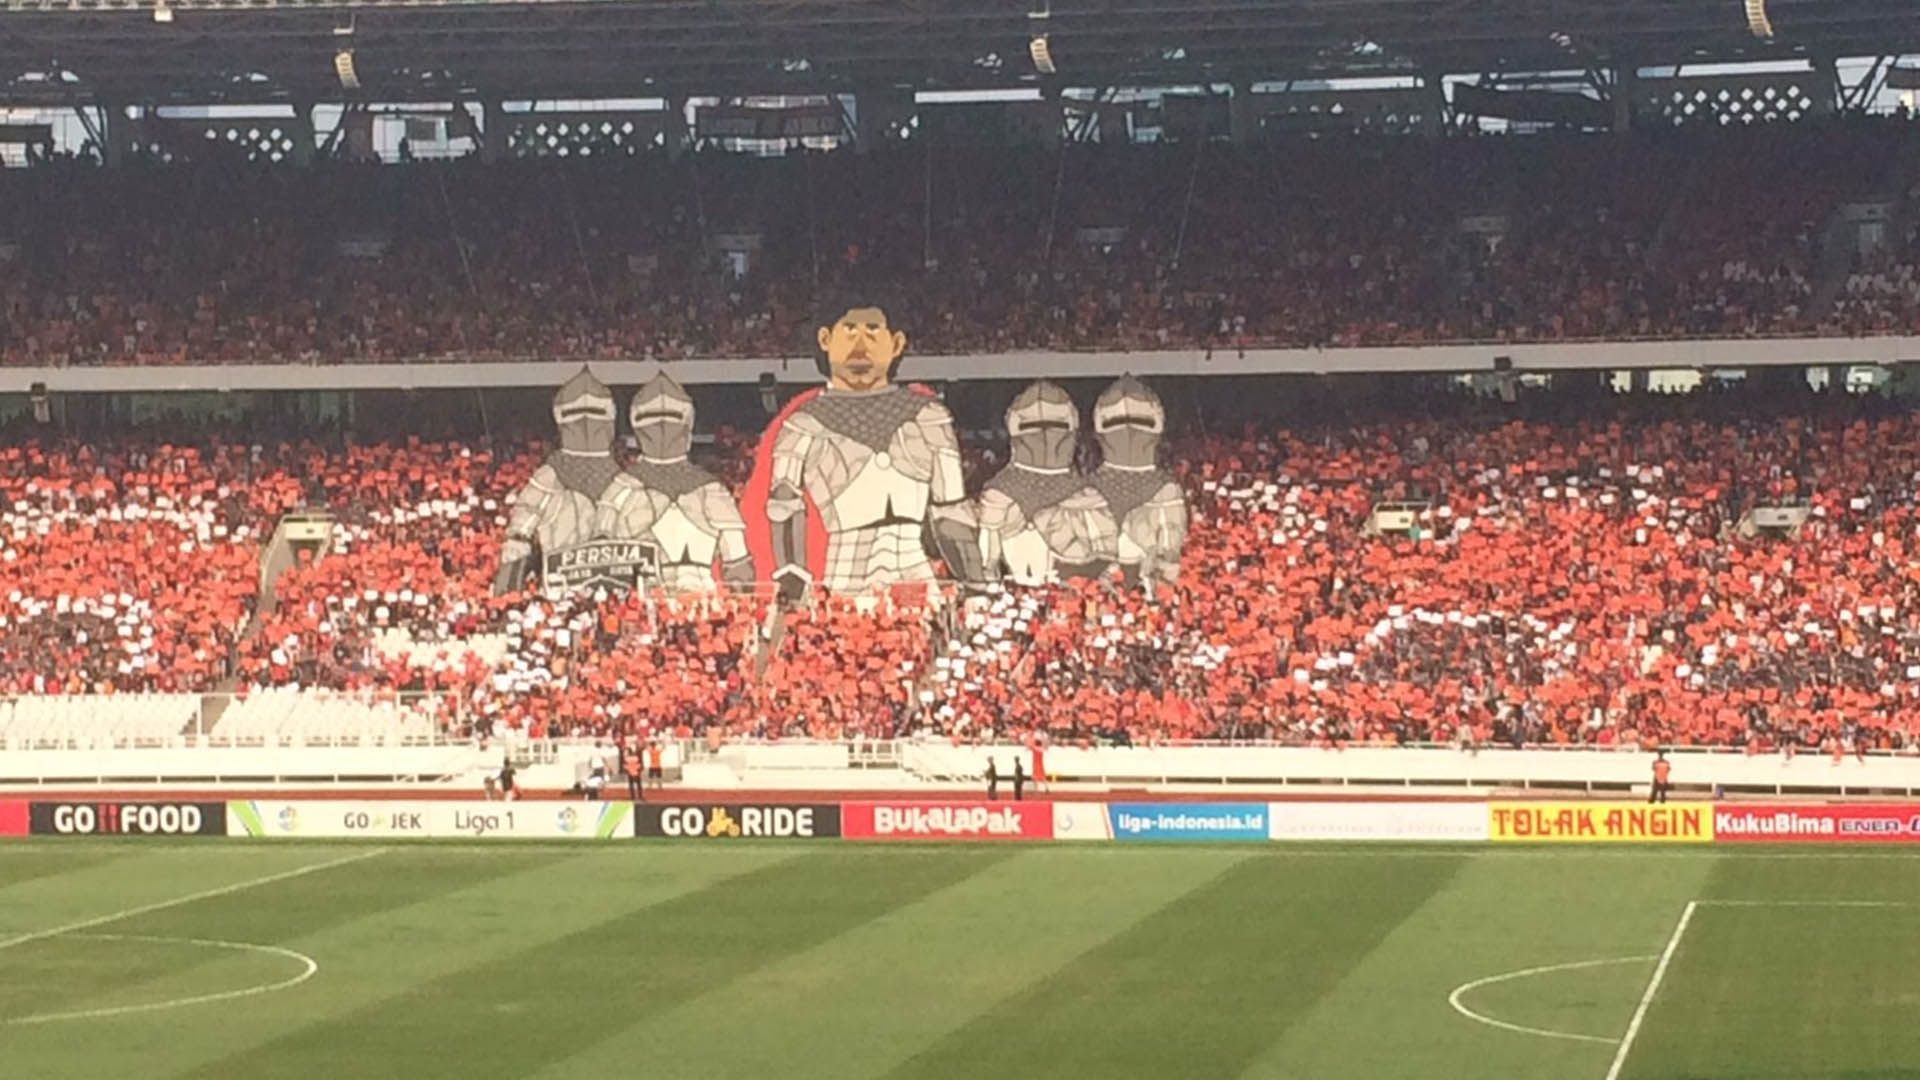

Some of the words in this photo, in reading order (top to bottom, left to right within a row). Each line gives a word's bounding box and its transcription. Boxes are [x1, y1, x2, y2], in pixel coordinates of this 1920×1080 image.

[562, 545, 640, 565] PERSIJA
[54, 805, 95, 833] GO
[120, 806, 201, 833] FOOD
[344, 812, 369, 829] GO
[391, 813, 422, 829] JEK
[455, 810, 499, 835] Liga
[506, 811, 514, 829] 1
[661, 807, 704, 836] GO
[741, 807, 813, 836] RIDE
[1118, 813, 1262, 832] liga-indonesia.id
[1493, 809, 1597, 836] TOLAK
[1604, 809, 1700, 836] ANGIN
[1716, 813, 1834, 834] KukuBima
